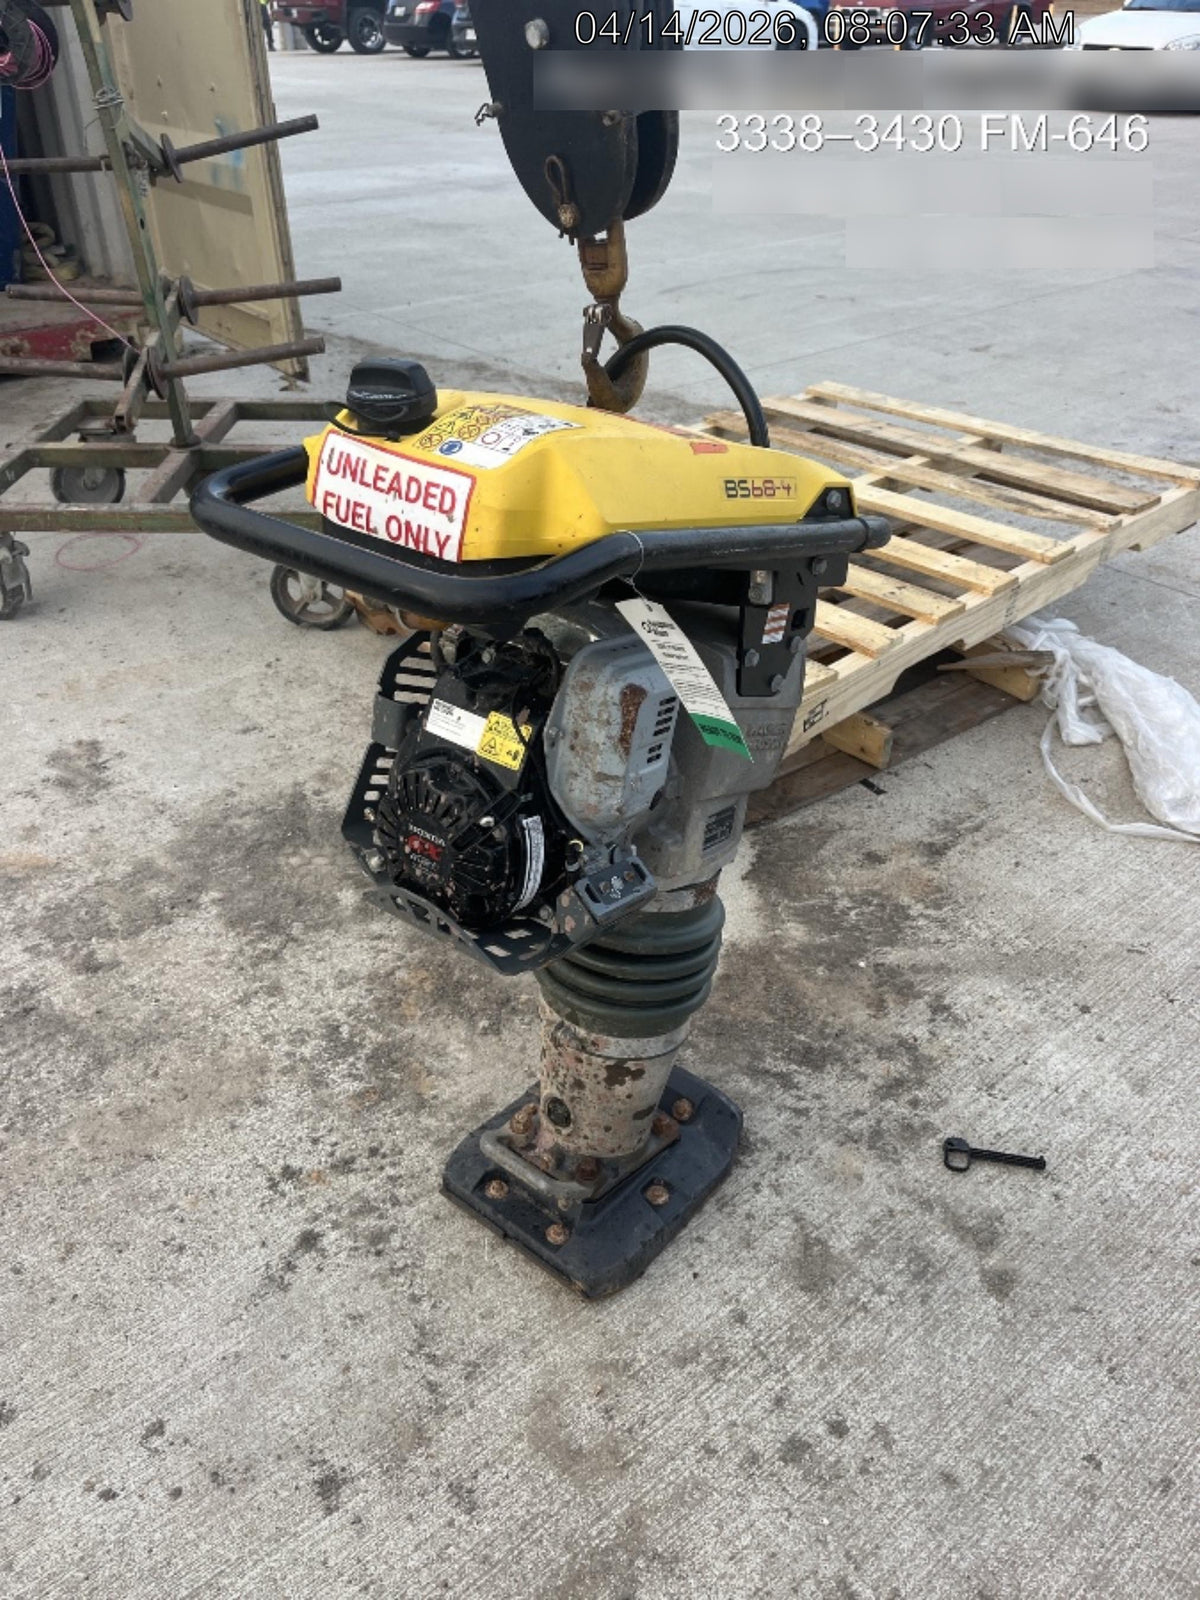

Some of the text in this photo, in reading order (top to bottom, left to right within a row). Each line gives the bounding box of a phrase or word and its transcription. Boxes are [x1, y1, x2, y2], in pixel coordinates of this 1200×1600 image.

[326, 447, 457, 515] UNLEADED
[723, 479, 792, 498] BS68-4
[322, 490, 452, 560] FUEL ONLY
